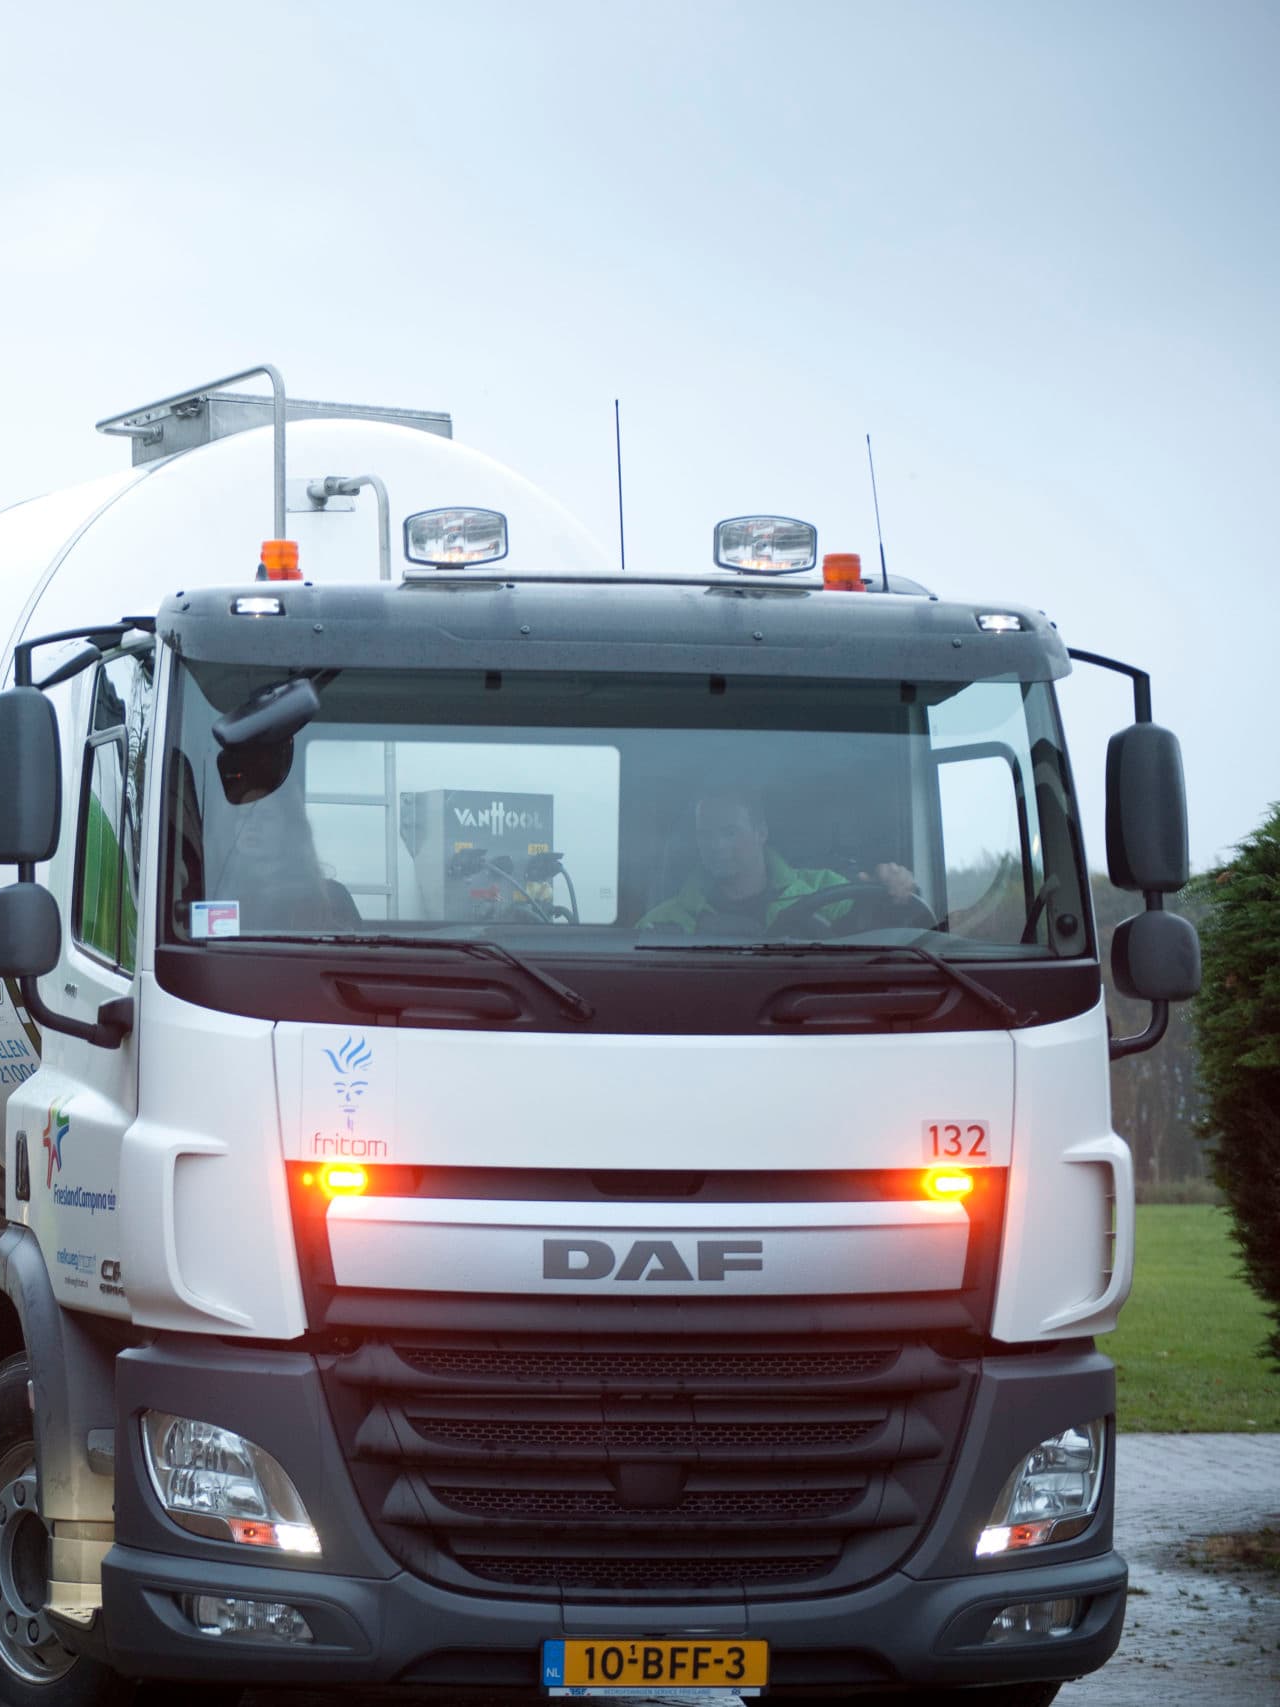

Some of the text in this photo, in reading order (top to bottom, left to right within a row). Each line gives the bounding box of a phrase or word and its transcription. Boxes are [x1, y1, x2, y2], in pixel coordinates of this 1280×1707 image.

[314, 1132, 387, 1157] fritom
[928, 1124, 987, 1157] 132
[53, 1183, 107, 1215] FrieslandCampina
[542, 1239, 763, 1281] DAF
[546, 1668, 561, 1678] NL
